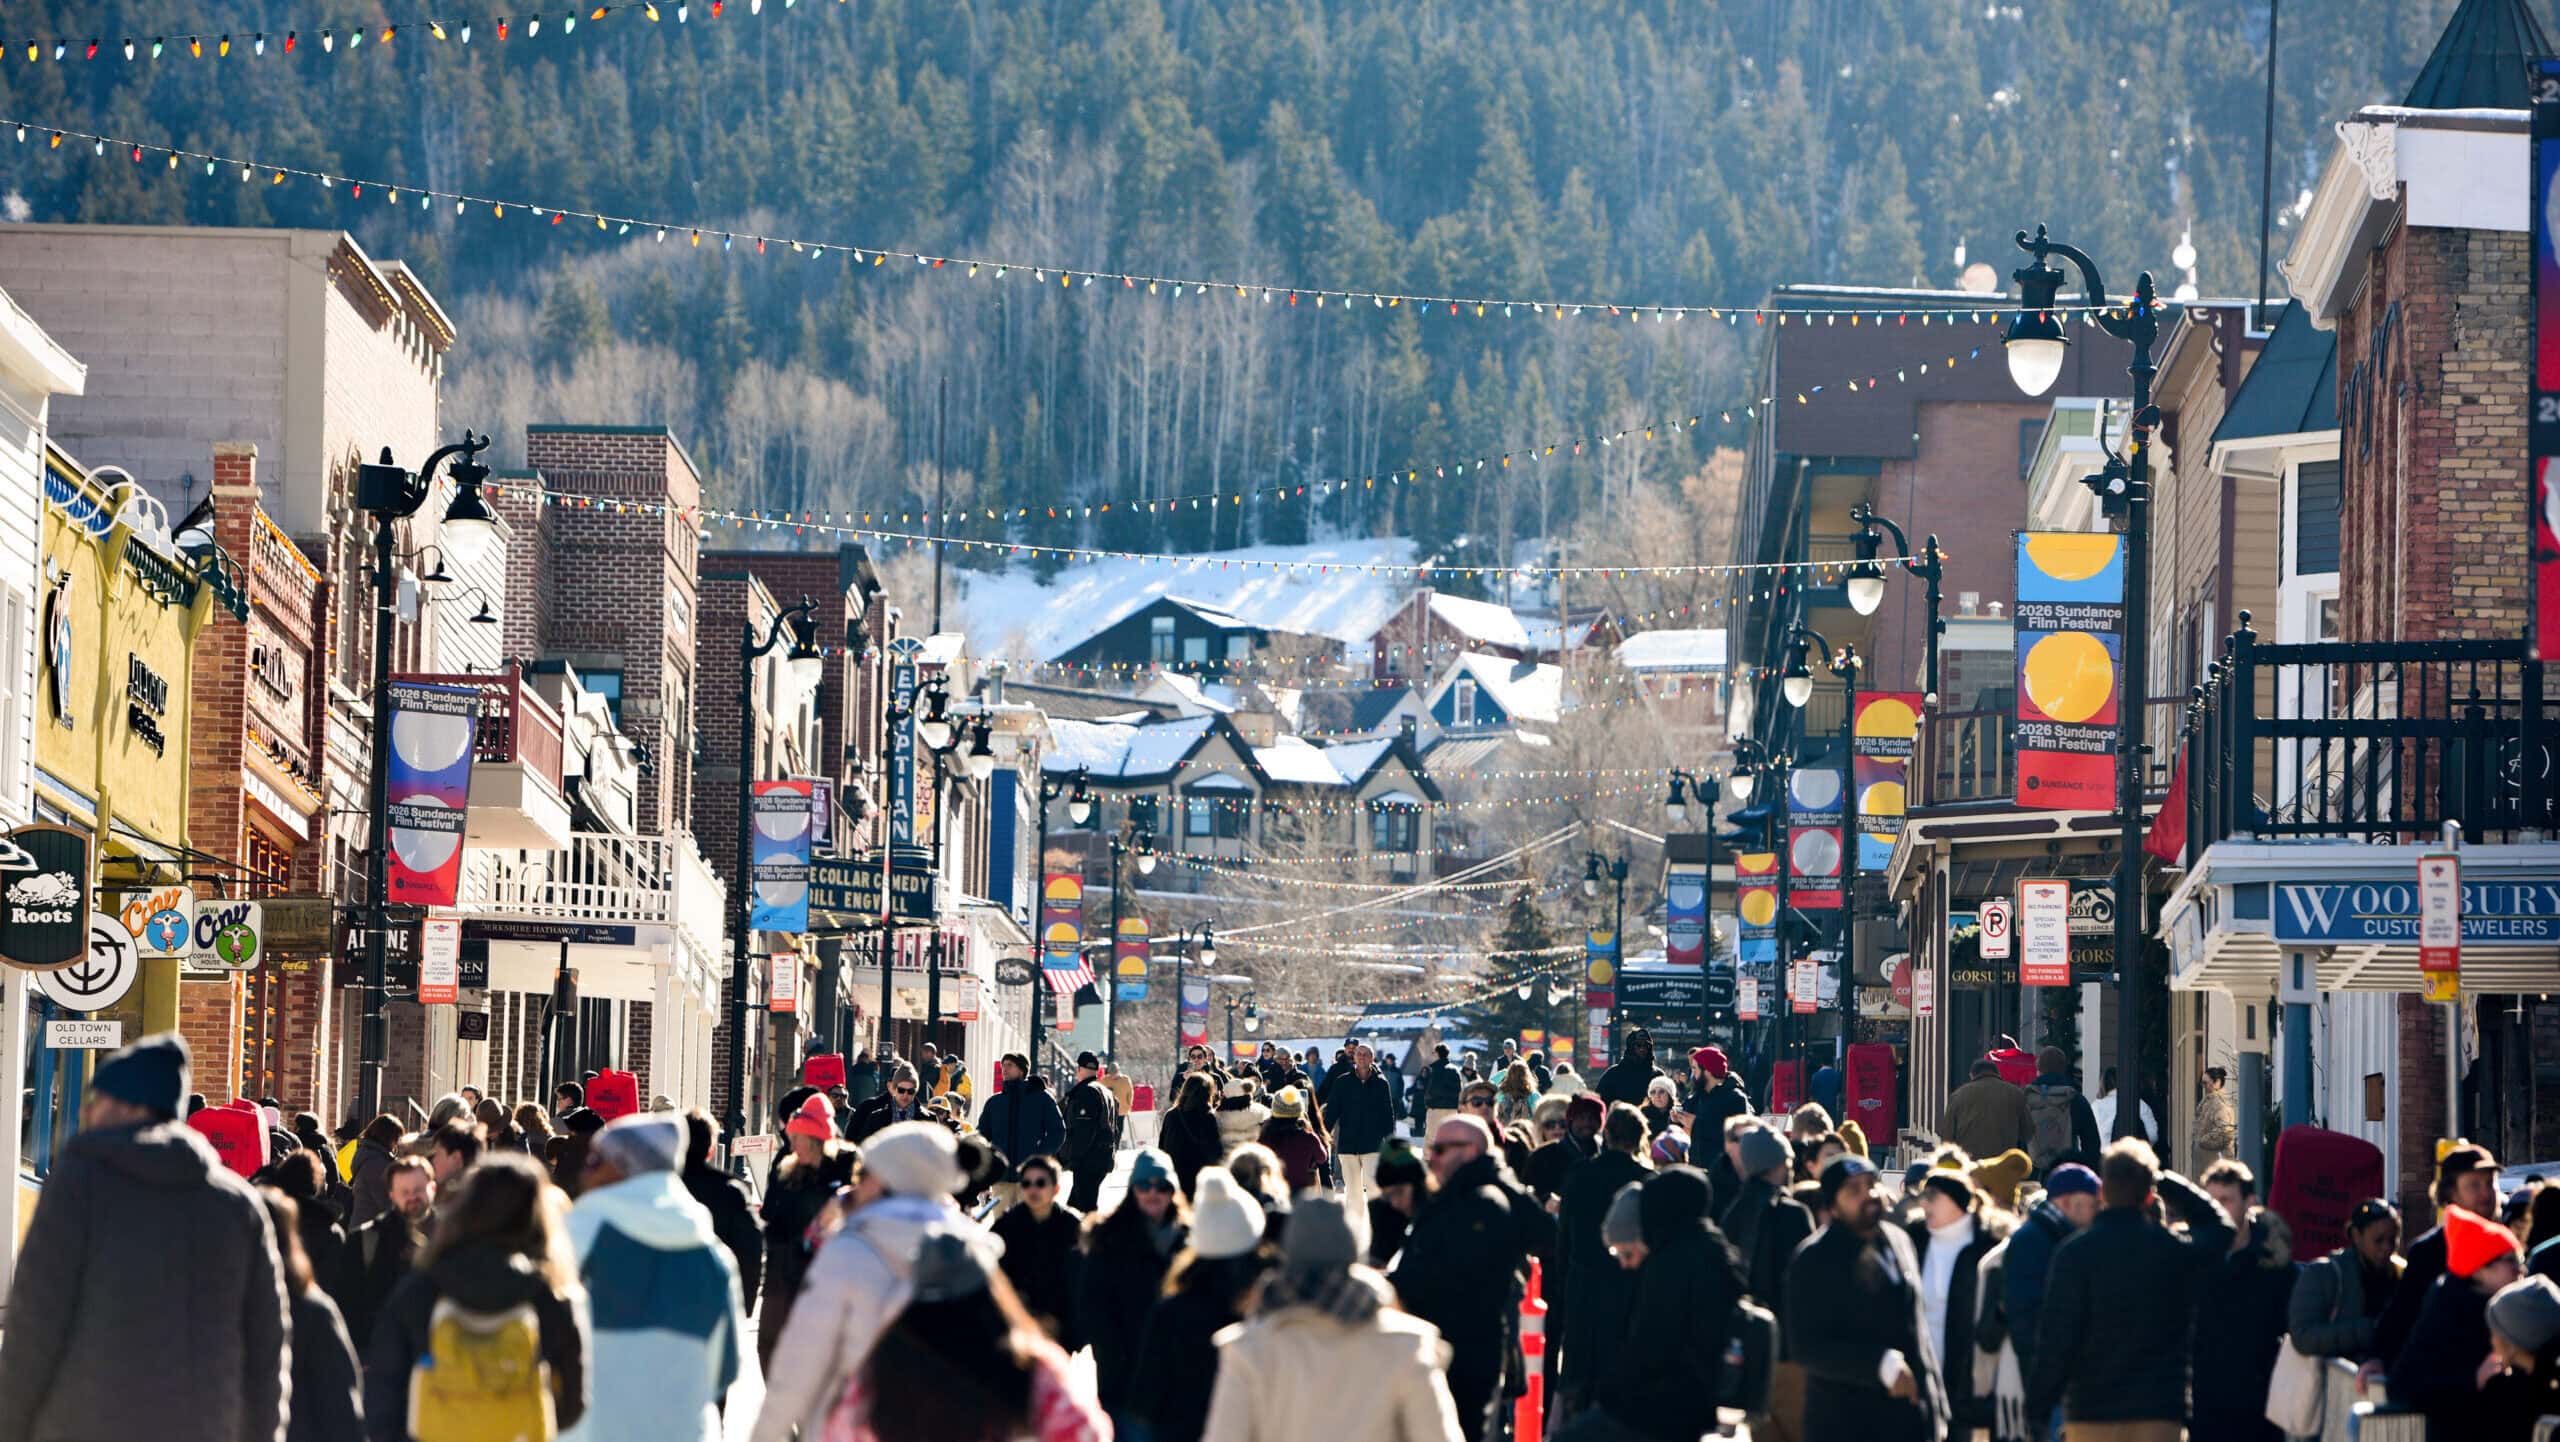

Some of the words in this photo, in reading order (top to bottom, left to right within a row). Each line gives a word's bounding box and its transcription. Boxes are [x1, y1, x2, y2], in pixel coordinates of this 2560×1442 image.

[2017, 604, 2053, 616] 2026
[2055, 605, 2122, 619] Sundance
[2028, 616, 2058, 629] Film
[2060, 616, 2113, 630] Festival
[392, 687, 420, 700] 2026
[421, 690, 477, 705] Sundance
[400, 698, 424, 710] Film
[425, 700, 468, 713] Festival
[2017, 723, 2052, 736] 2026
[2054, 724, 2116, 740] Sundance
[1878, 737, 1911, 747] Sundan
[2028, 735, 2057, 748] Film
[2058, 737, 2106, 753] Festival
[1861, 746, 1880, 754] Film
[1881, 745, 1913, 755] Festiva
[388, 804, 410, 818] 2026
[410, 807, 465, 821] Sundance
[395, 815, 413, 827] Film
[414, 817, 455, 830] Festival
[1863, 824, 1881, 832] Film
[819, 867, 870, 888] COLLAR
[873, 872, 929, 894] CMEDY
[128, 893, 149, 901] JAVA
[844, 890, 908, 913] ENGVLL
[11, 907, 73, 924] Roots
[199, 906, 219, 915] JAVA
[2070, 905, 2090, 916] BOY
[2279, 884, 2560, 936] WOOBURY
[532, 924, 580, 936] HATHAWAY
[2363, 919, 2420, 936] CUSTO
[2461, 919, 2548, 936] EWELERS
[2069, 947, 2113, 964] GORS
[1952, 970, 2016, 984] GORSUH
[1626, 981, 1664, 993] Treasure
[1665, 980, 1703, 990] Mountai
[1709, 984, 1725, 995] Inn
[55, 1023, 77, 1033] OLD
[79, 1023, 111, 1033] TOWN
[59, 1036, 107, 1045] CELLARS
